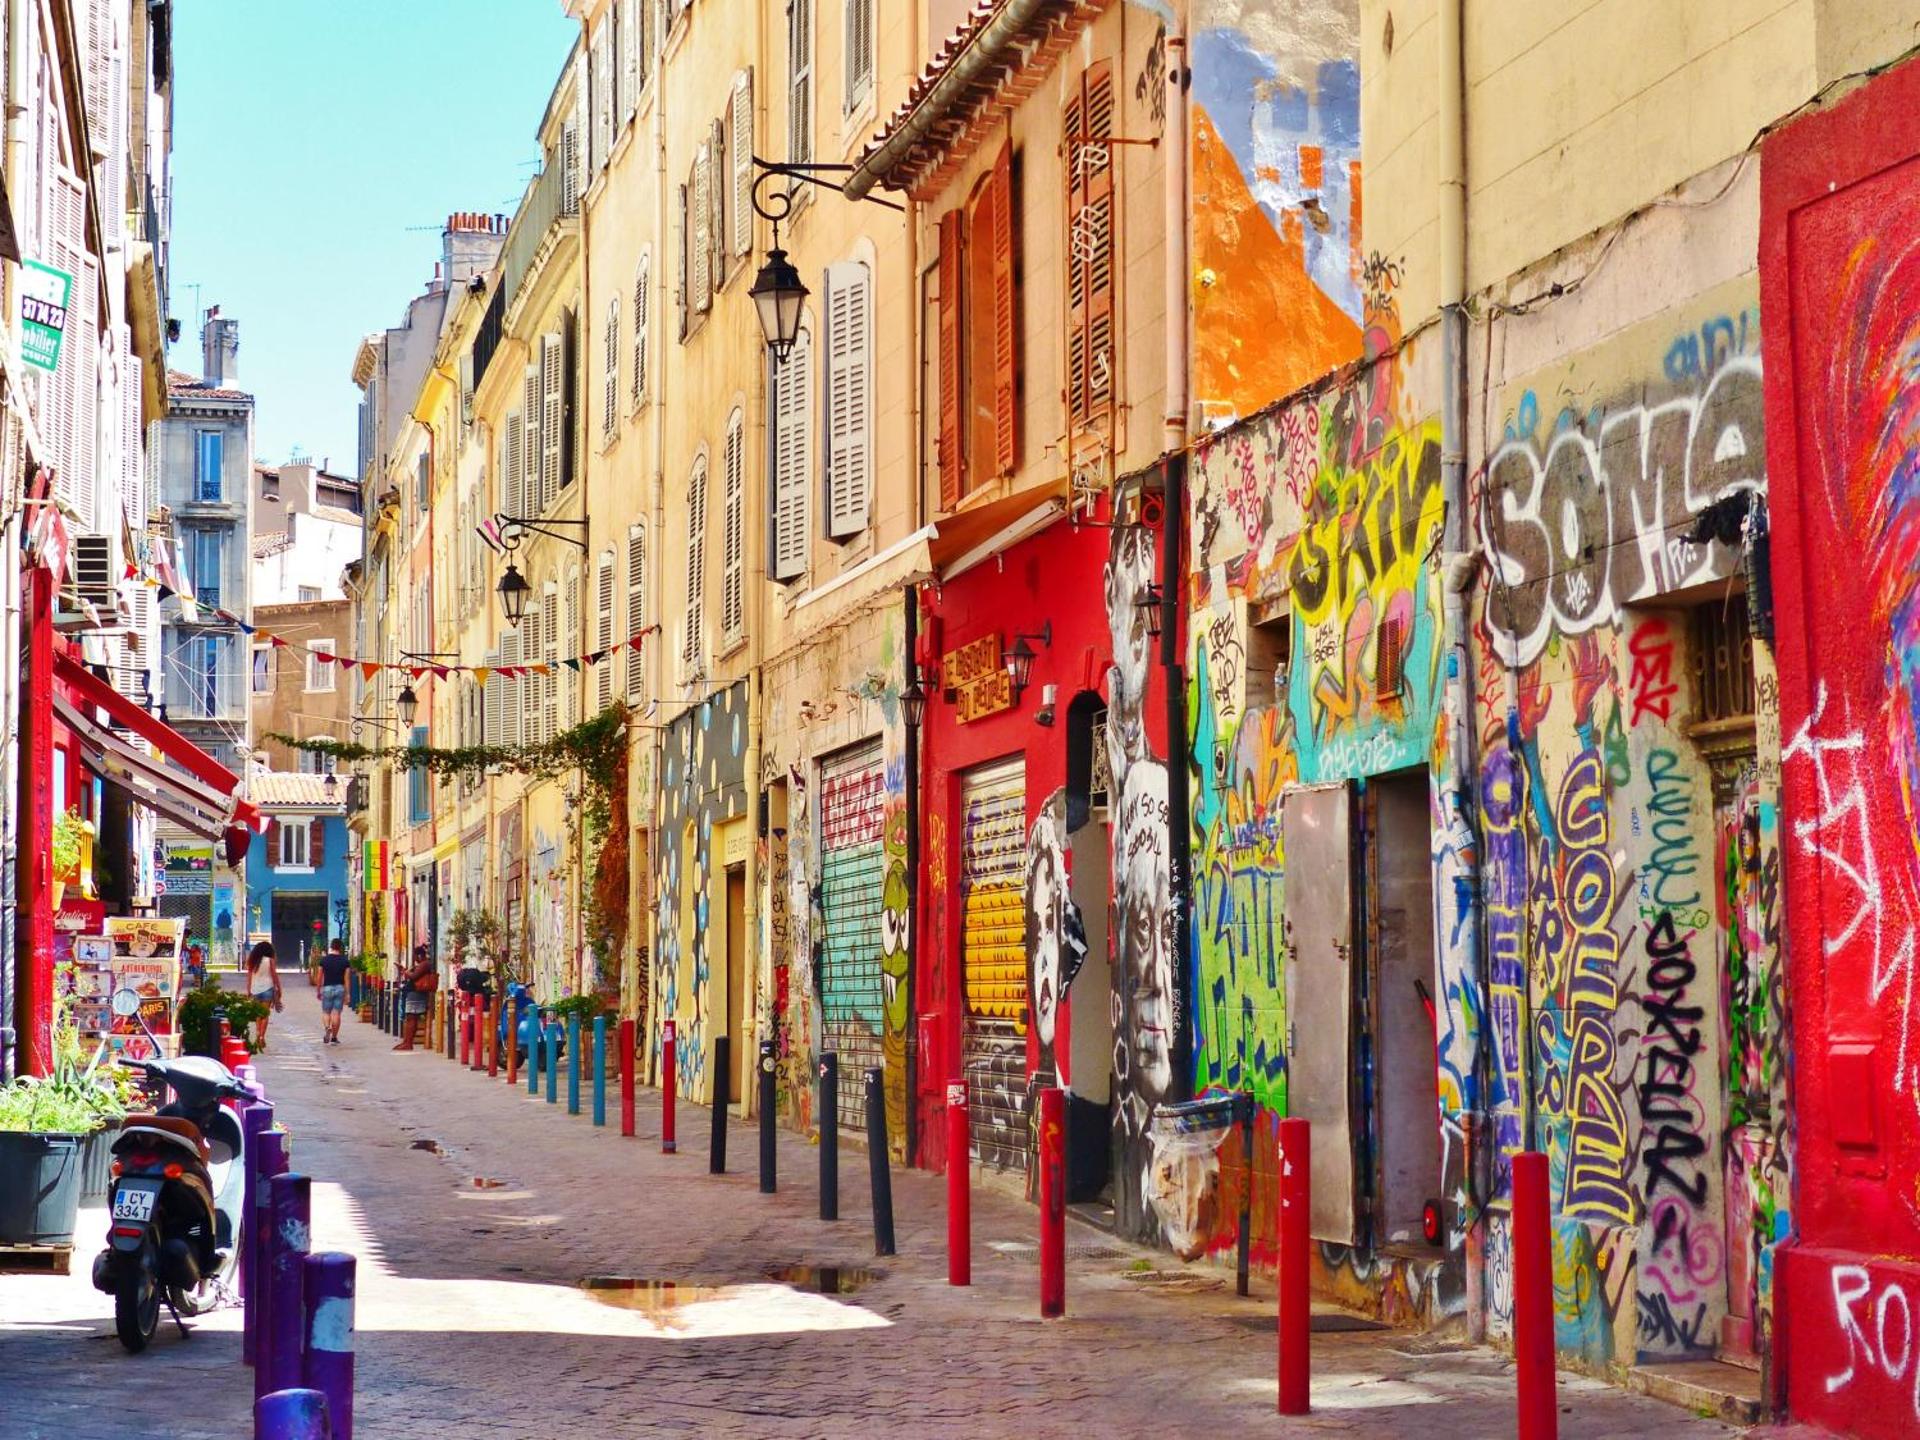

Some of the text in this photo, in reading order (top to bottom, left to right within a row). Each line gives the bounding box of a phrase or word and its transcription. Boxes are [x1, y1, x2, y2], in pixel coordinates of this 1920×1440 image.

[129, 1192, 147, 1205] CY
[115, 1205, 151, 1219] 334 T
